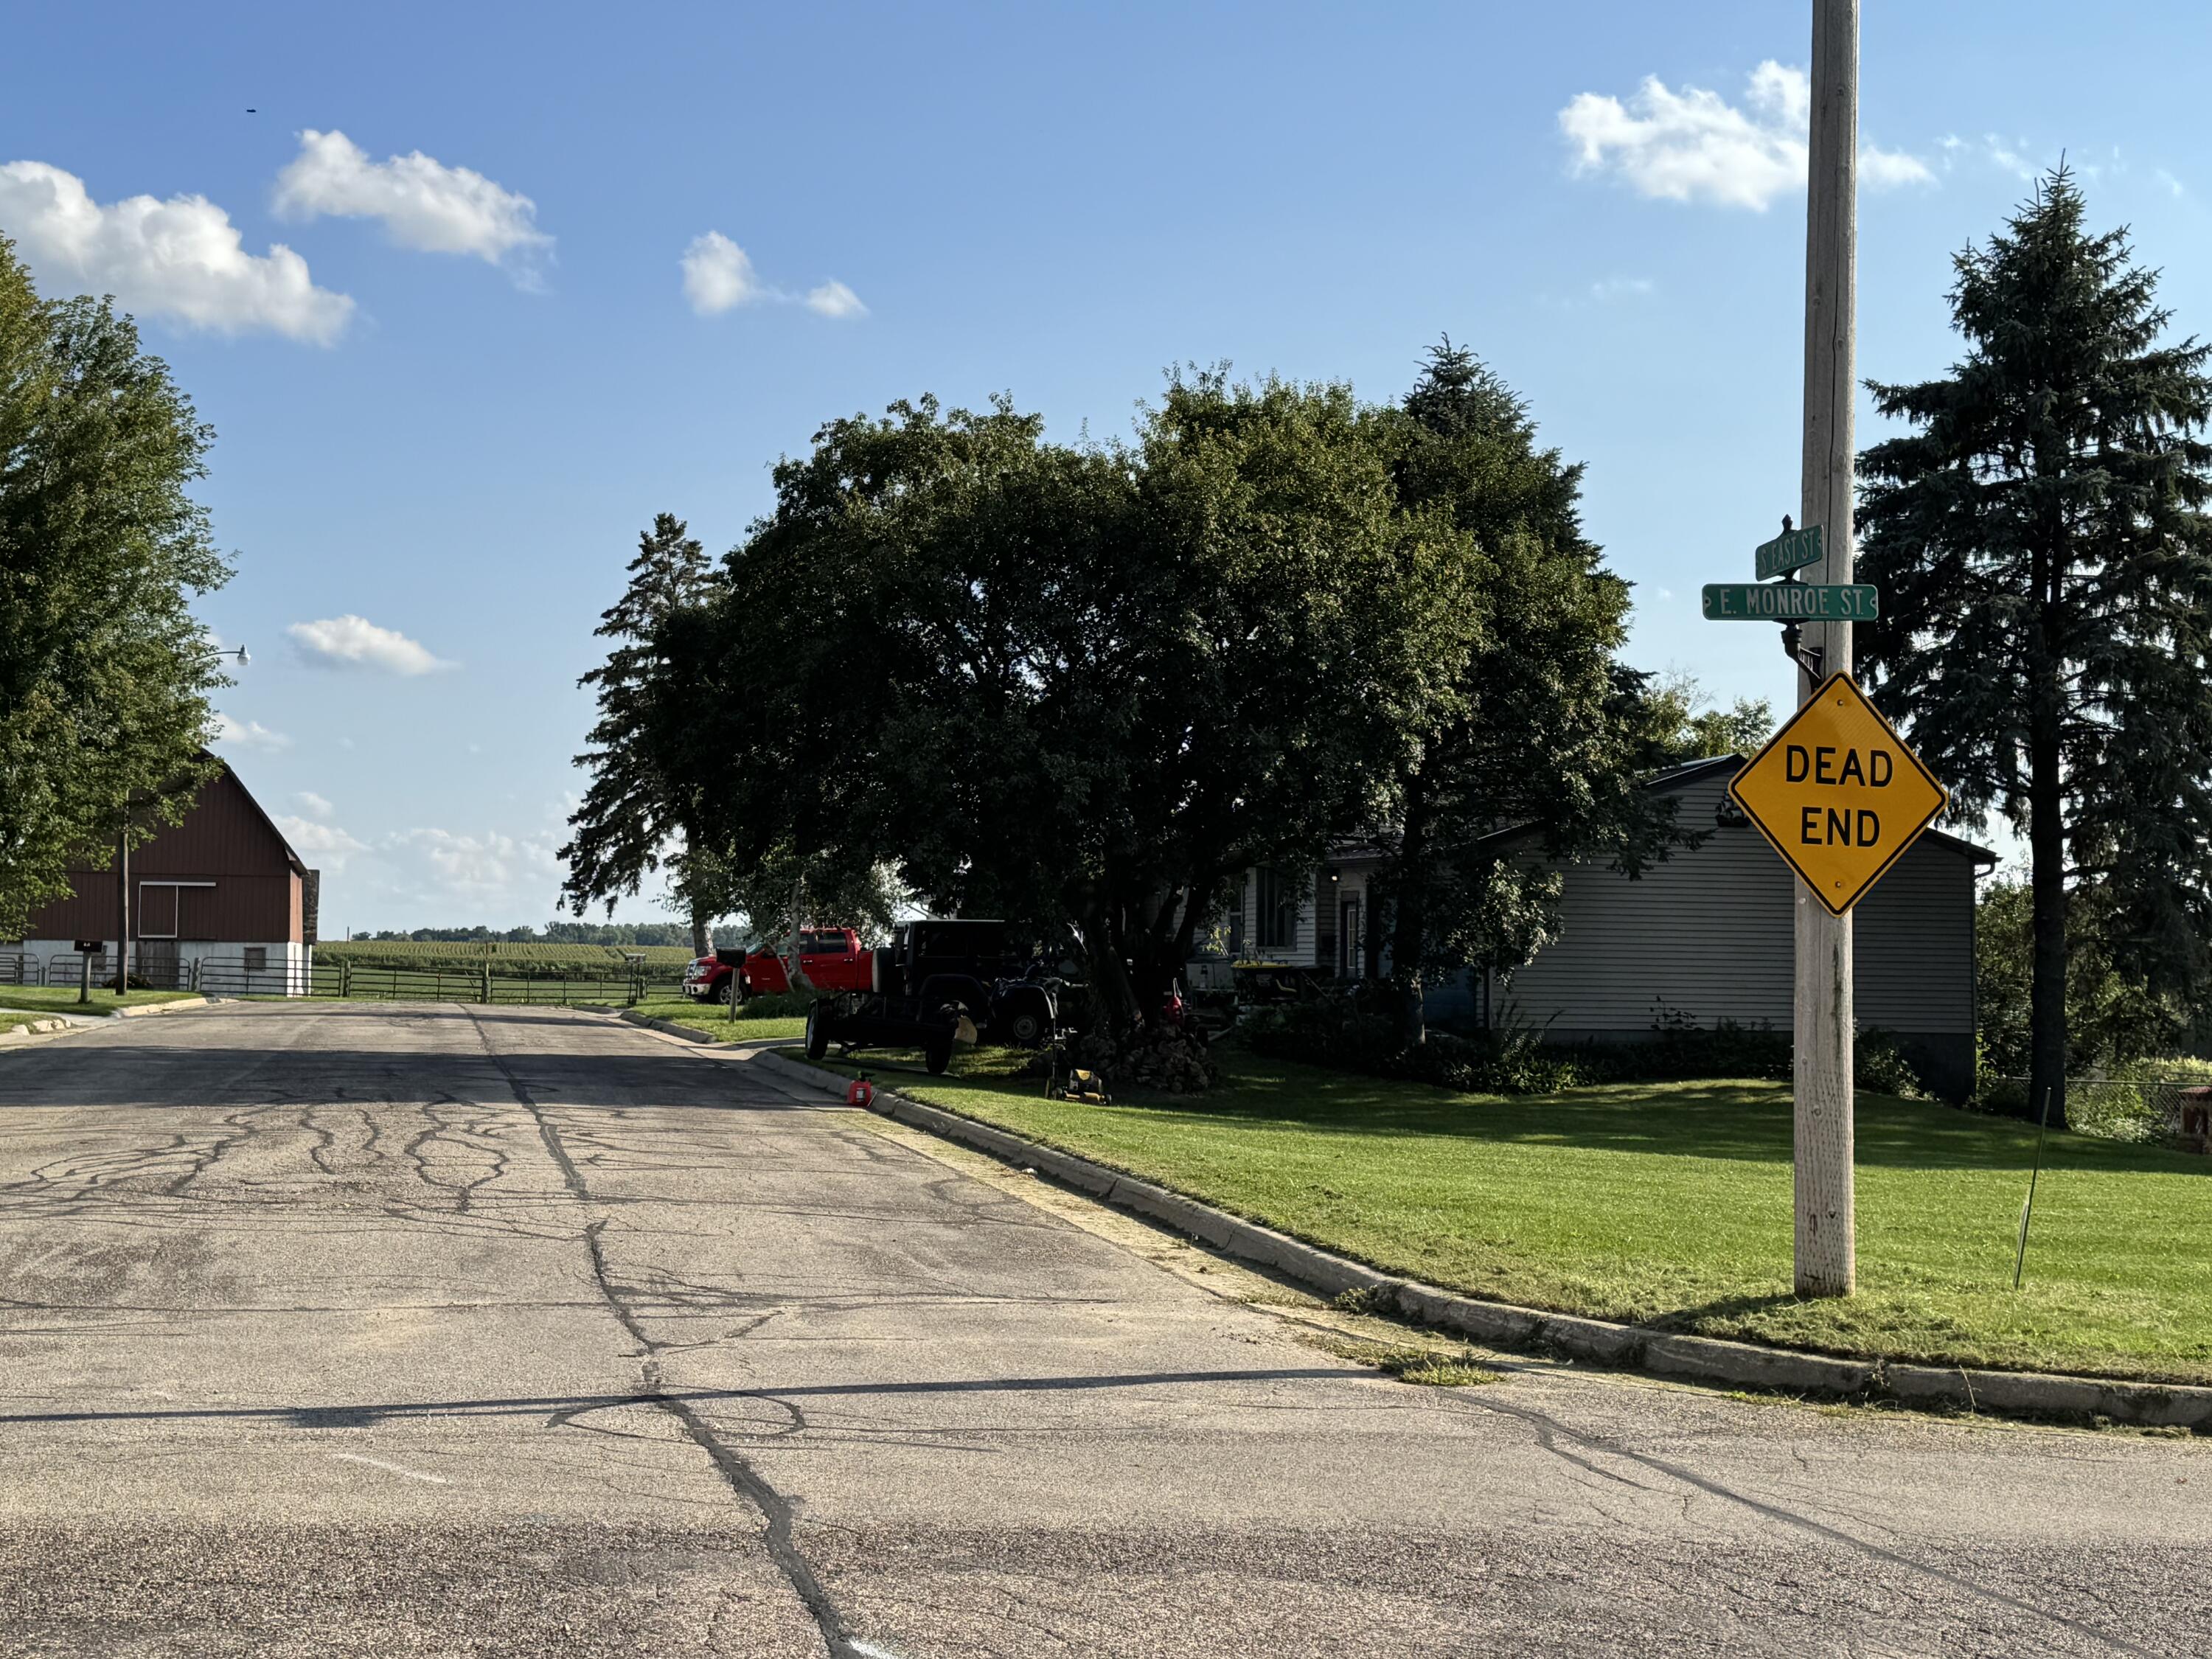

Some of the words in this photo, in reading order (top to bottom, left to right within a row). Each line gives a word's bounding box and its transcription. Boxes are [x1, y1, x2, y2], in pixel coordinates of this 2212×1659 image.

[1771, 536, 1797, 570] EAST
[1720, 589, 1736, 614] E.
[1747, 588, 1829, 615] MONROE
[1840, 589, 1863, 616] ST.
[1786, 744, 1893, 787] DEAD
[1801, 806, 1880, 847] END
